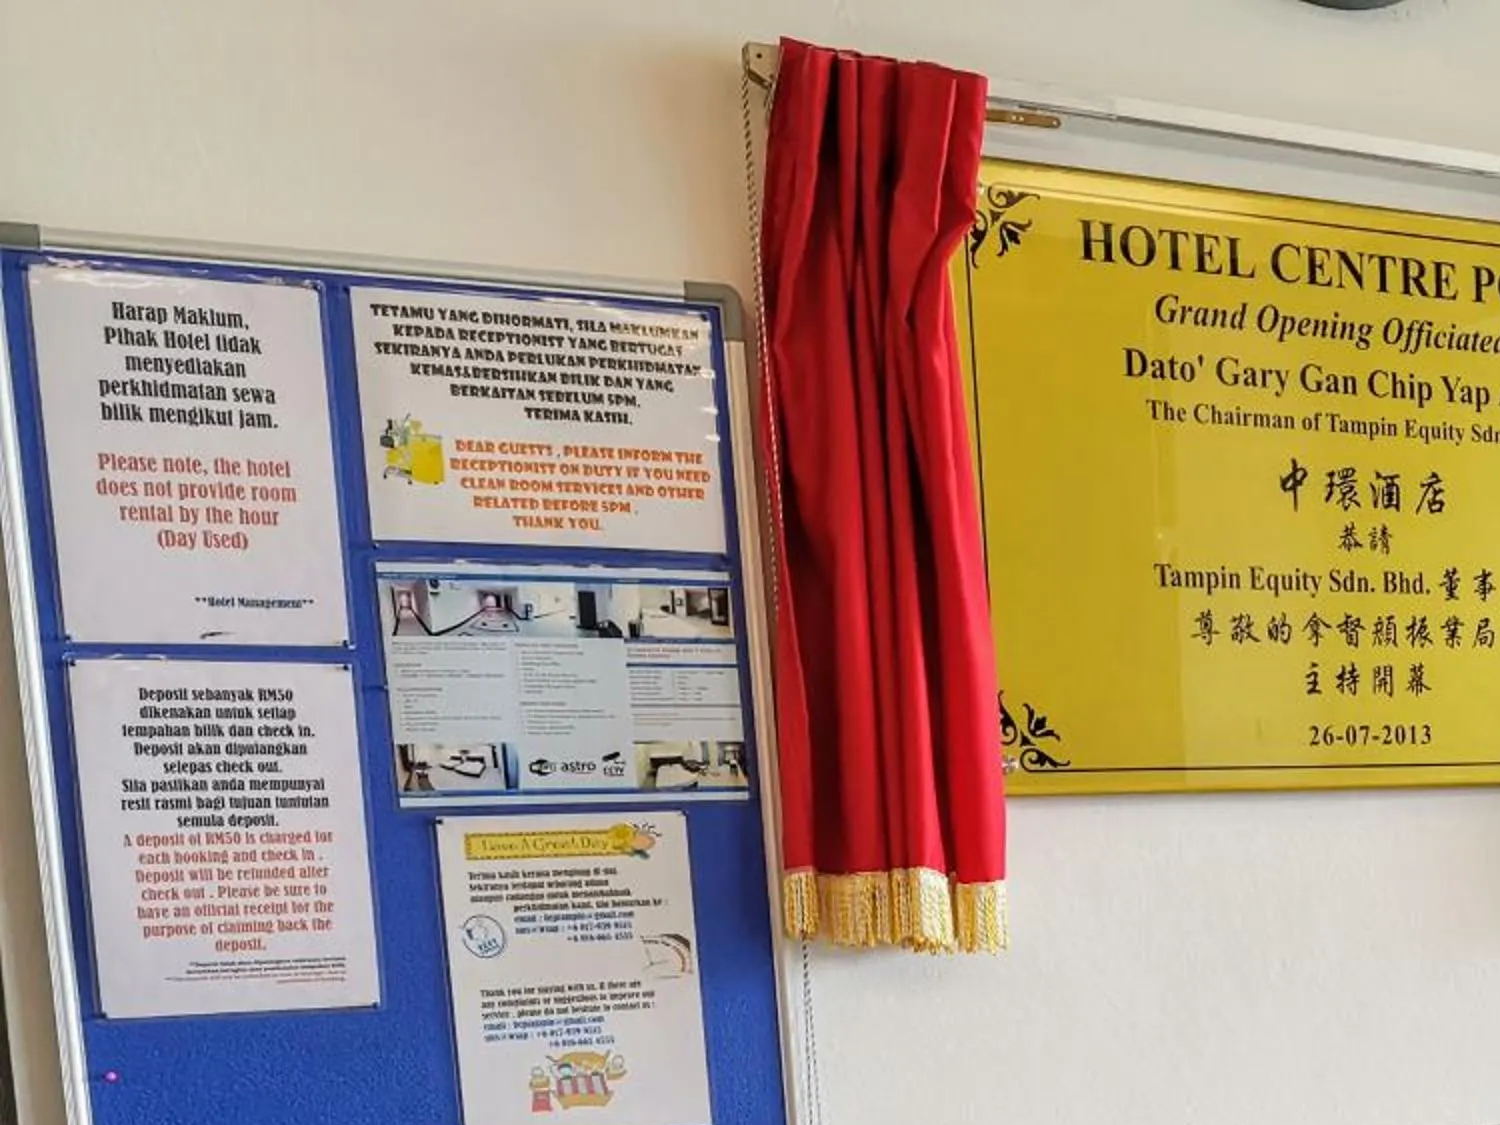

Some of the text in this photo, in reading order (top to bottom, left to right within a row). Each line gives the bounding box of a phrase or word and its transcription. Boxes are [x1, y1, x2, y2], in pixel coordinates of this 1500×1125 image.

[1080, 220, 1254, 278] HOTEL
[1271, 243, 1457, 300] CENTRE
[112, 301, 167, 324] Harap
[1155, 294, 1247, 330] Grand
[1257, 304, 1373, 350] Opening
[104, 326, 261, 354] Pihak Hotel tidak
[125, 355, 246, 378] menyediakan
[98, 378, 275, 404] perkhidmatan sewa
[603, 375, 632, 388] DAN
[1123, 348, 1203, 382] Dato'
[1216, 357, 1288, 396] Gary
[1300, 363, 1357, 395] Gan
[1367, 369, 1432, 408] Chip
[1440, 375, 1490, 412] Yap
[100, 402, 278, 428] bilik mengikut jam.
[1146, 399, 1186, 422] The
[1193, 403, 1294, 429] Chairman
[1301, 412, 1322, 431] of
[1325, 413, 1397, 440] Tampin
[1405, 419, 1464, 446] Equity
[97, 453, 157, 472] Please
[213, 457, 240, 476] the
[247, 459, 290, 478] hotel
[96, 477, 296, 502] does not provide room
[1280, 458, 1444, 514] 中環酒店
[119, 504, 278, 525] rental by the hour
[157, 529, 248, 550] (Day Used)
[1153, 563, 1240, 595] Tampin
[1249, 566, 1321, 598] Equity
[1329, 568, 1375, 592] Sdn.
[1383, 571, 1430, 594] Bhd.
[1310, 724, 1430, 746] 26-07-2013
[560, 761, 596, 773] astro
